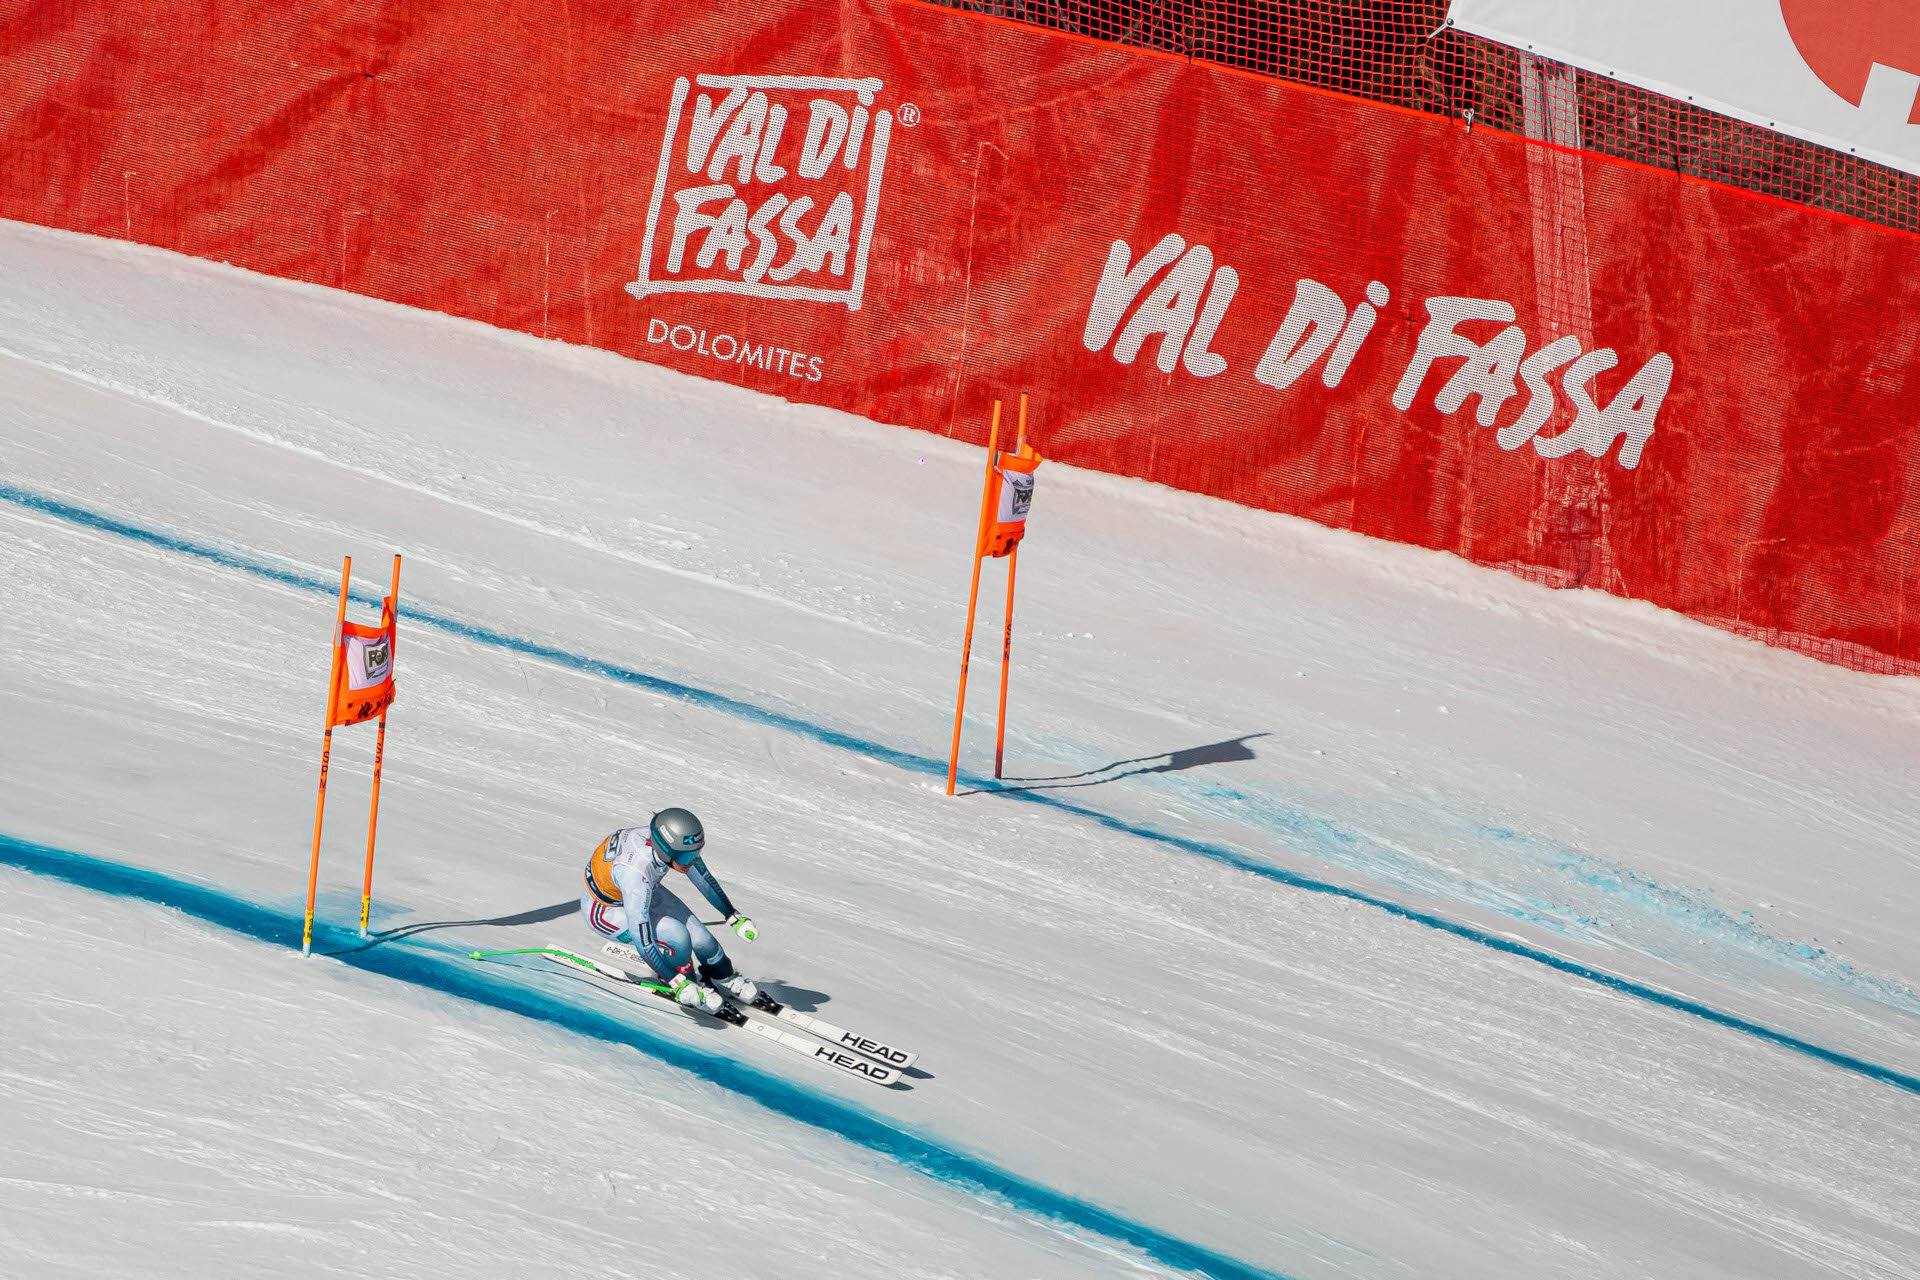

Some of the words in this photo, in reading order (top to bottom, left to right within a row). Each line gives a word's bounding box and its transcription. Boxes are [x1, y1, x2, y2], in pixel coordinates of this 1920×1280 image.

[686, 88, 788, 184] VAL
[666, 184, 853, 283] FASSA
[646, 318, 824, 382] DOLOMITES
[1083, 233, 1240, 377] VAL
[1392, 296, 1674, 470] FASSA
[815, 1047, 889, 1080] HEAD
[841, 1032, 908, 1063] HEAD
